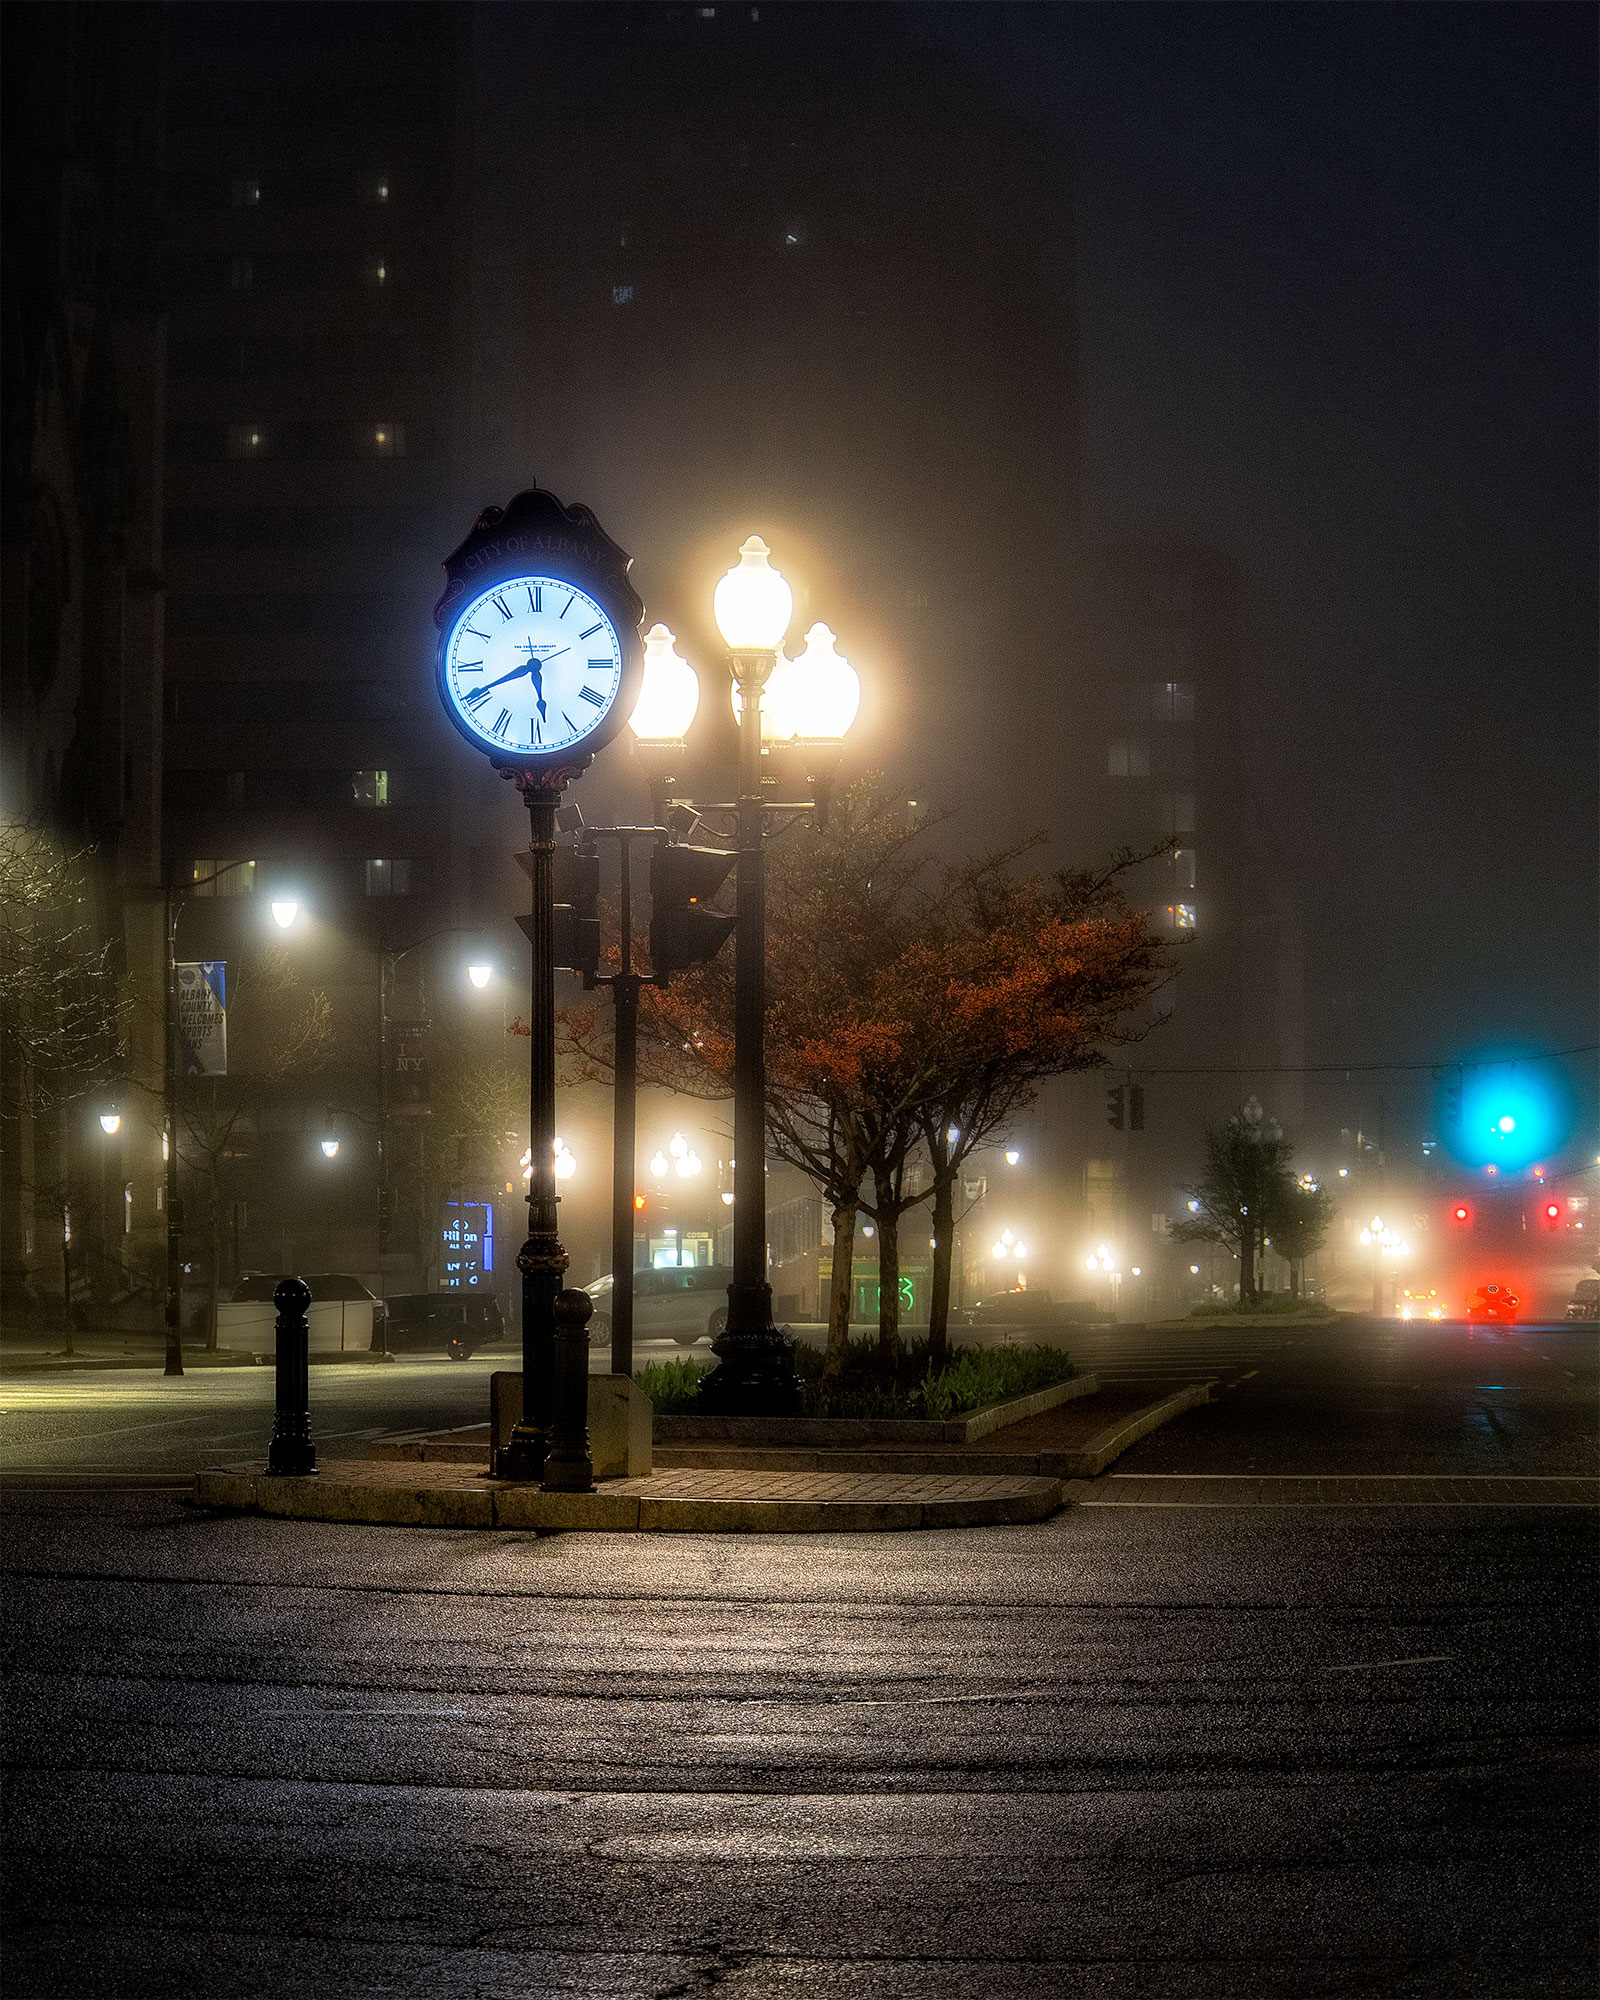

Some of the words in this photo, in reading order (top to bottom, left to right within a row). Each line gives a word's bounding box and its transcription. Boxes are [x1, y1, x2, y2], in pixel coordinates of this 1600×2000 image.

[465, 541, 502, 570] CITY
[506, 535, 528, 552] OF
[533, 535, 606, 566] ALBANY
[527, 586, 543, 614] XII
[491, 595, 515, 624] XI
[180, 988, 212, 1001] ALBANY
[180, 1001, 212, 1013] COUNTY
[180, 1013, 224, 1026] WELCOMES
[181, 1025, 212, 1037] SPORTS
[396, 1057, 425, 1071] NY
[443, 1230, 478, 1242] Hilon
